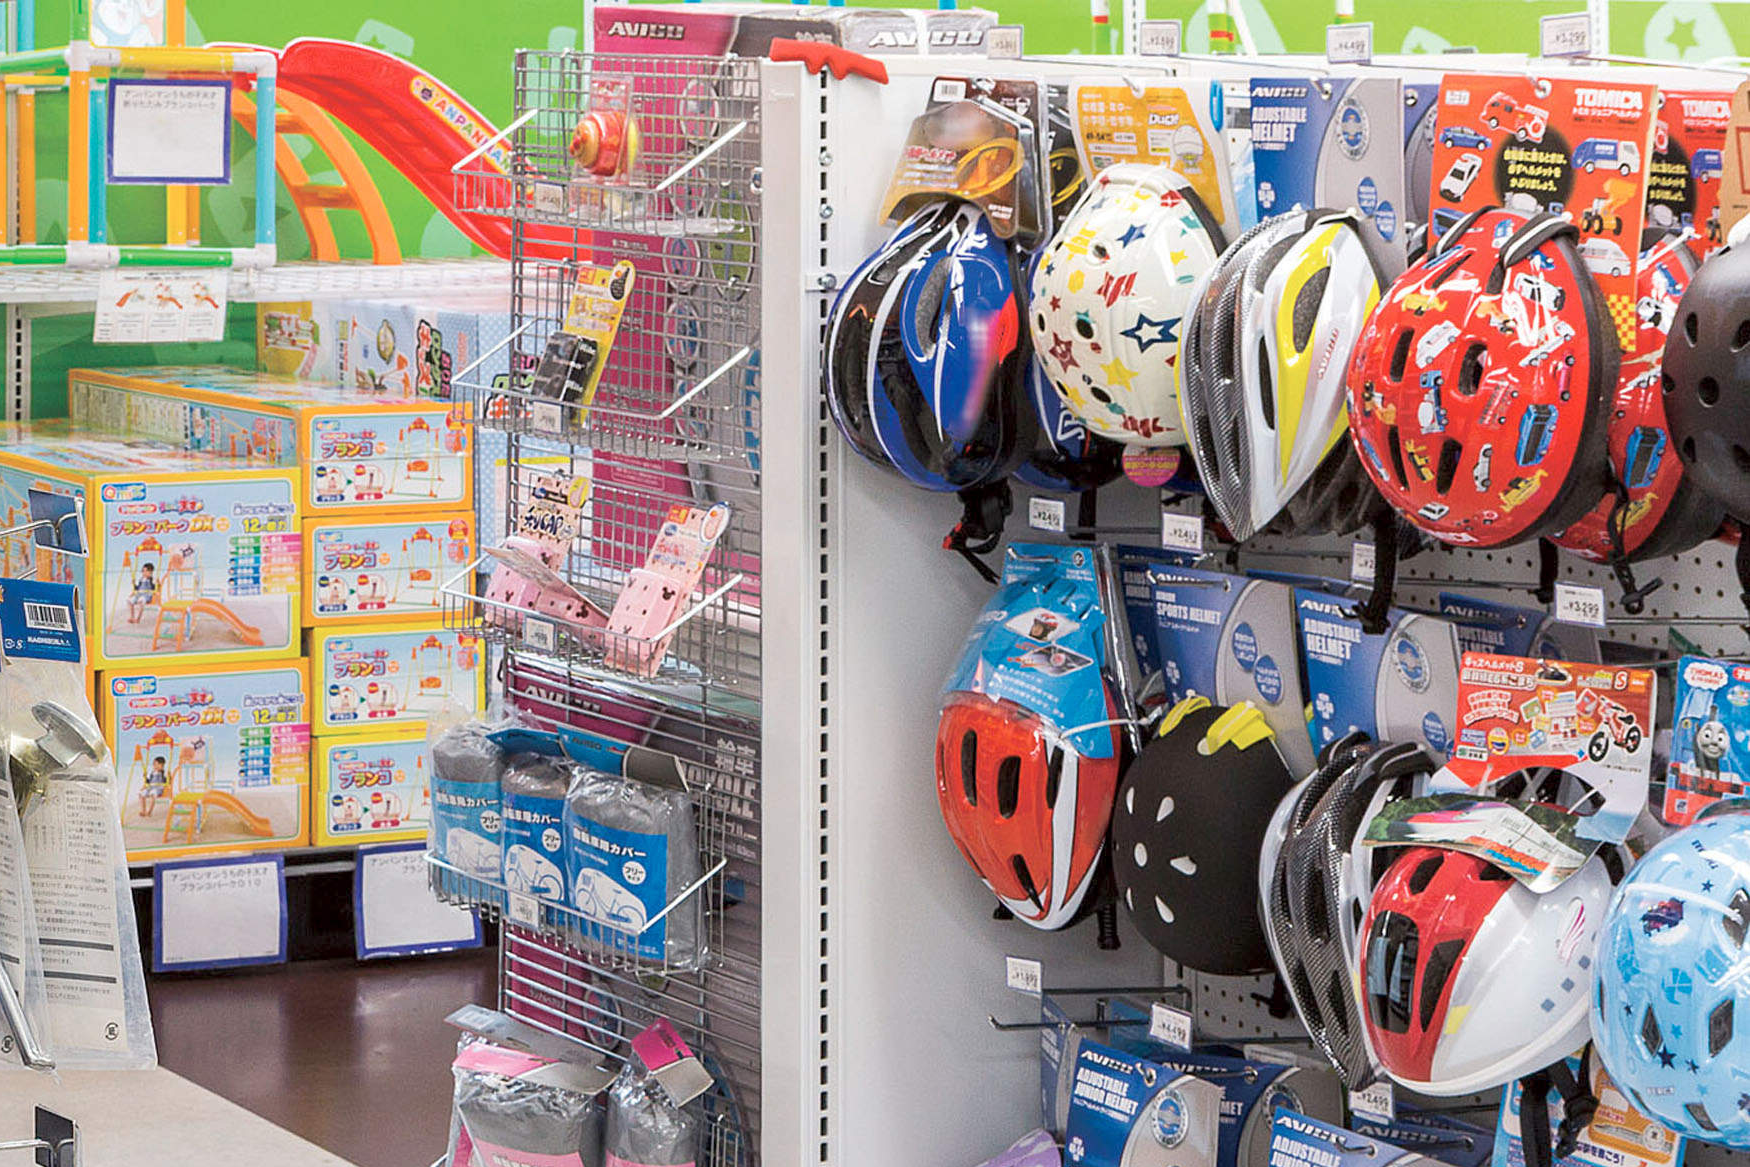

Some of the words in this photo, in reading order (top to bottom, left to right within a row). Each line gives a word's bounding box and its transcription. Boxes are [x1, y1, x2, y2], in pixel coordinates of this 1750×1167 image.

[868, 28, 984, 48] AVGO
[1575, 88, 1643, 110] TOMICA
[1252, 107, 1307, 122] ADJUSTABLE
[1252, 123, 1297, 142] HELMET
[322, 441, 373, 459] ブランコ
[110, 518, 189, 536] ブランコパーク
[324, 552, 377, 570] ブランコ
[1156, 602, 1187, 620] SPORTS
[1189, 608, 1221, 626] HELMET
[1300, 600, 1357, 618] AVI
[1304, 618, 1361, 643] ADJUSTABLE
[1457, 625, 1505, 645] DJUSTABLE
[1306, 633, 1352, 660] HELMET
[334, 660, 385, 678] ブランコ
[121, 712, 199, 731] ブランコパーク
[339, 770, 392, 789] ブランコ
[1077, 1067, 1130, 1098] ADJUSTABLE
[1074, 1084, 1106, 1105] JUNIOR
[1105, 1092, 1139, 1116] HELMET
